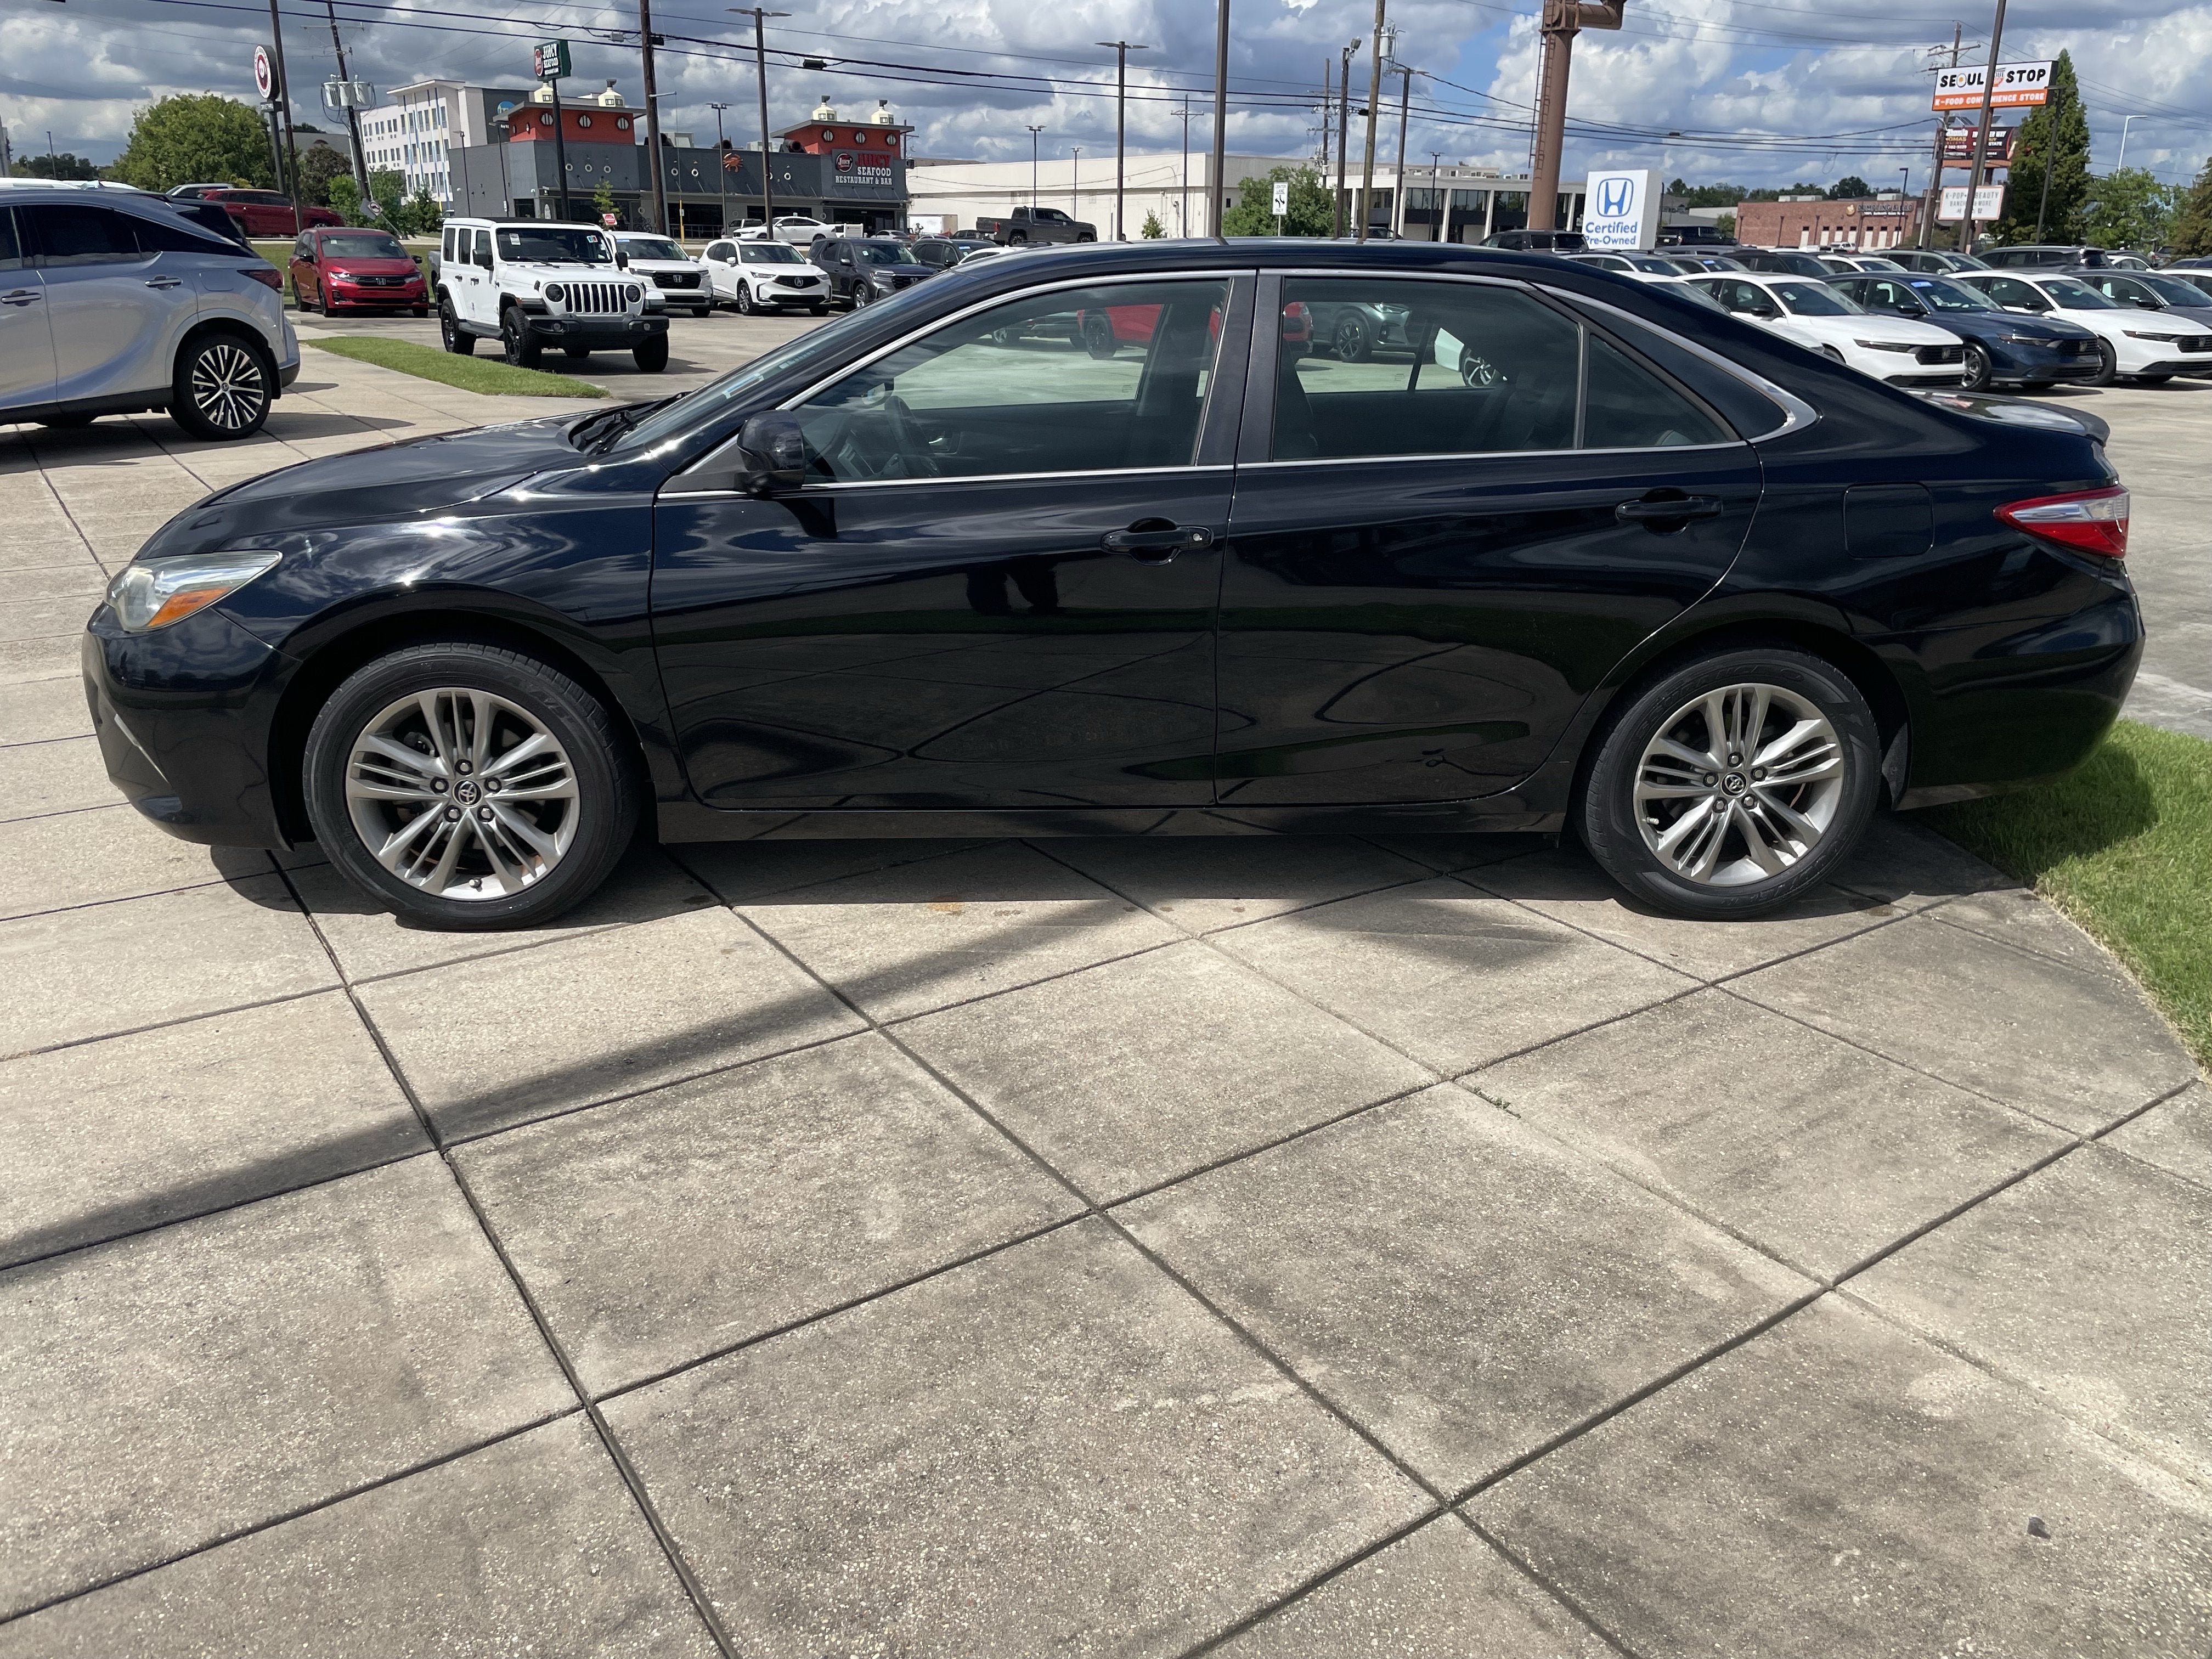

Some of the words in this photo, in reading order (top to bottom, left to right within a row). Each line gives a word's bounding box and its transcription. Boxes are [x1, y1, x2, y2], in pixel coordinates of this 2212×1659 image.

[543, 43, 557, 59] JUICY
[543, 57, 558, 68] SEAFOOD
[2006, 69, 2046, 83] STOP
[1935, 97, 1964, 106] K-FOOD
[1966, 94, 2017, 105] CONVNIENCE
[2019, 92, 2044, 101] STORE
[855, 153, 891, 167] JUICY
[857, 166, 891, 176] SEAFOOD
[836, 176, 873, 184] RESTAURANT
[875, 177, 879, 185] &
[1585, 221, 1638, 234] Certified
[1585, 235, 1637, 245] Pre-Owned
